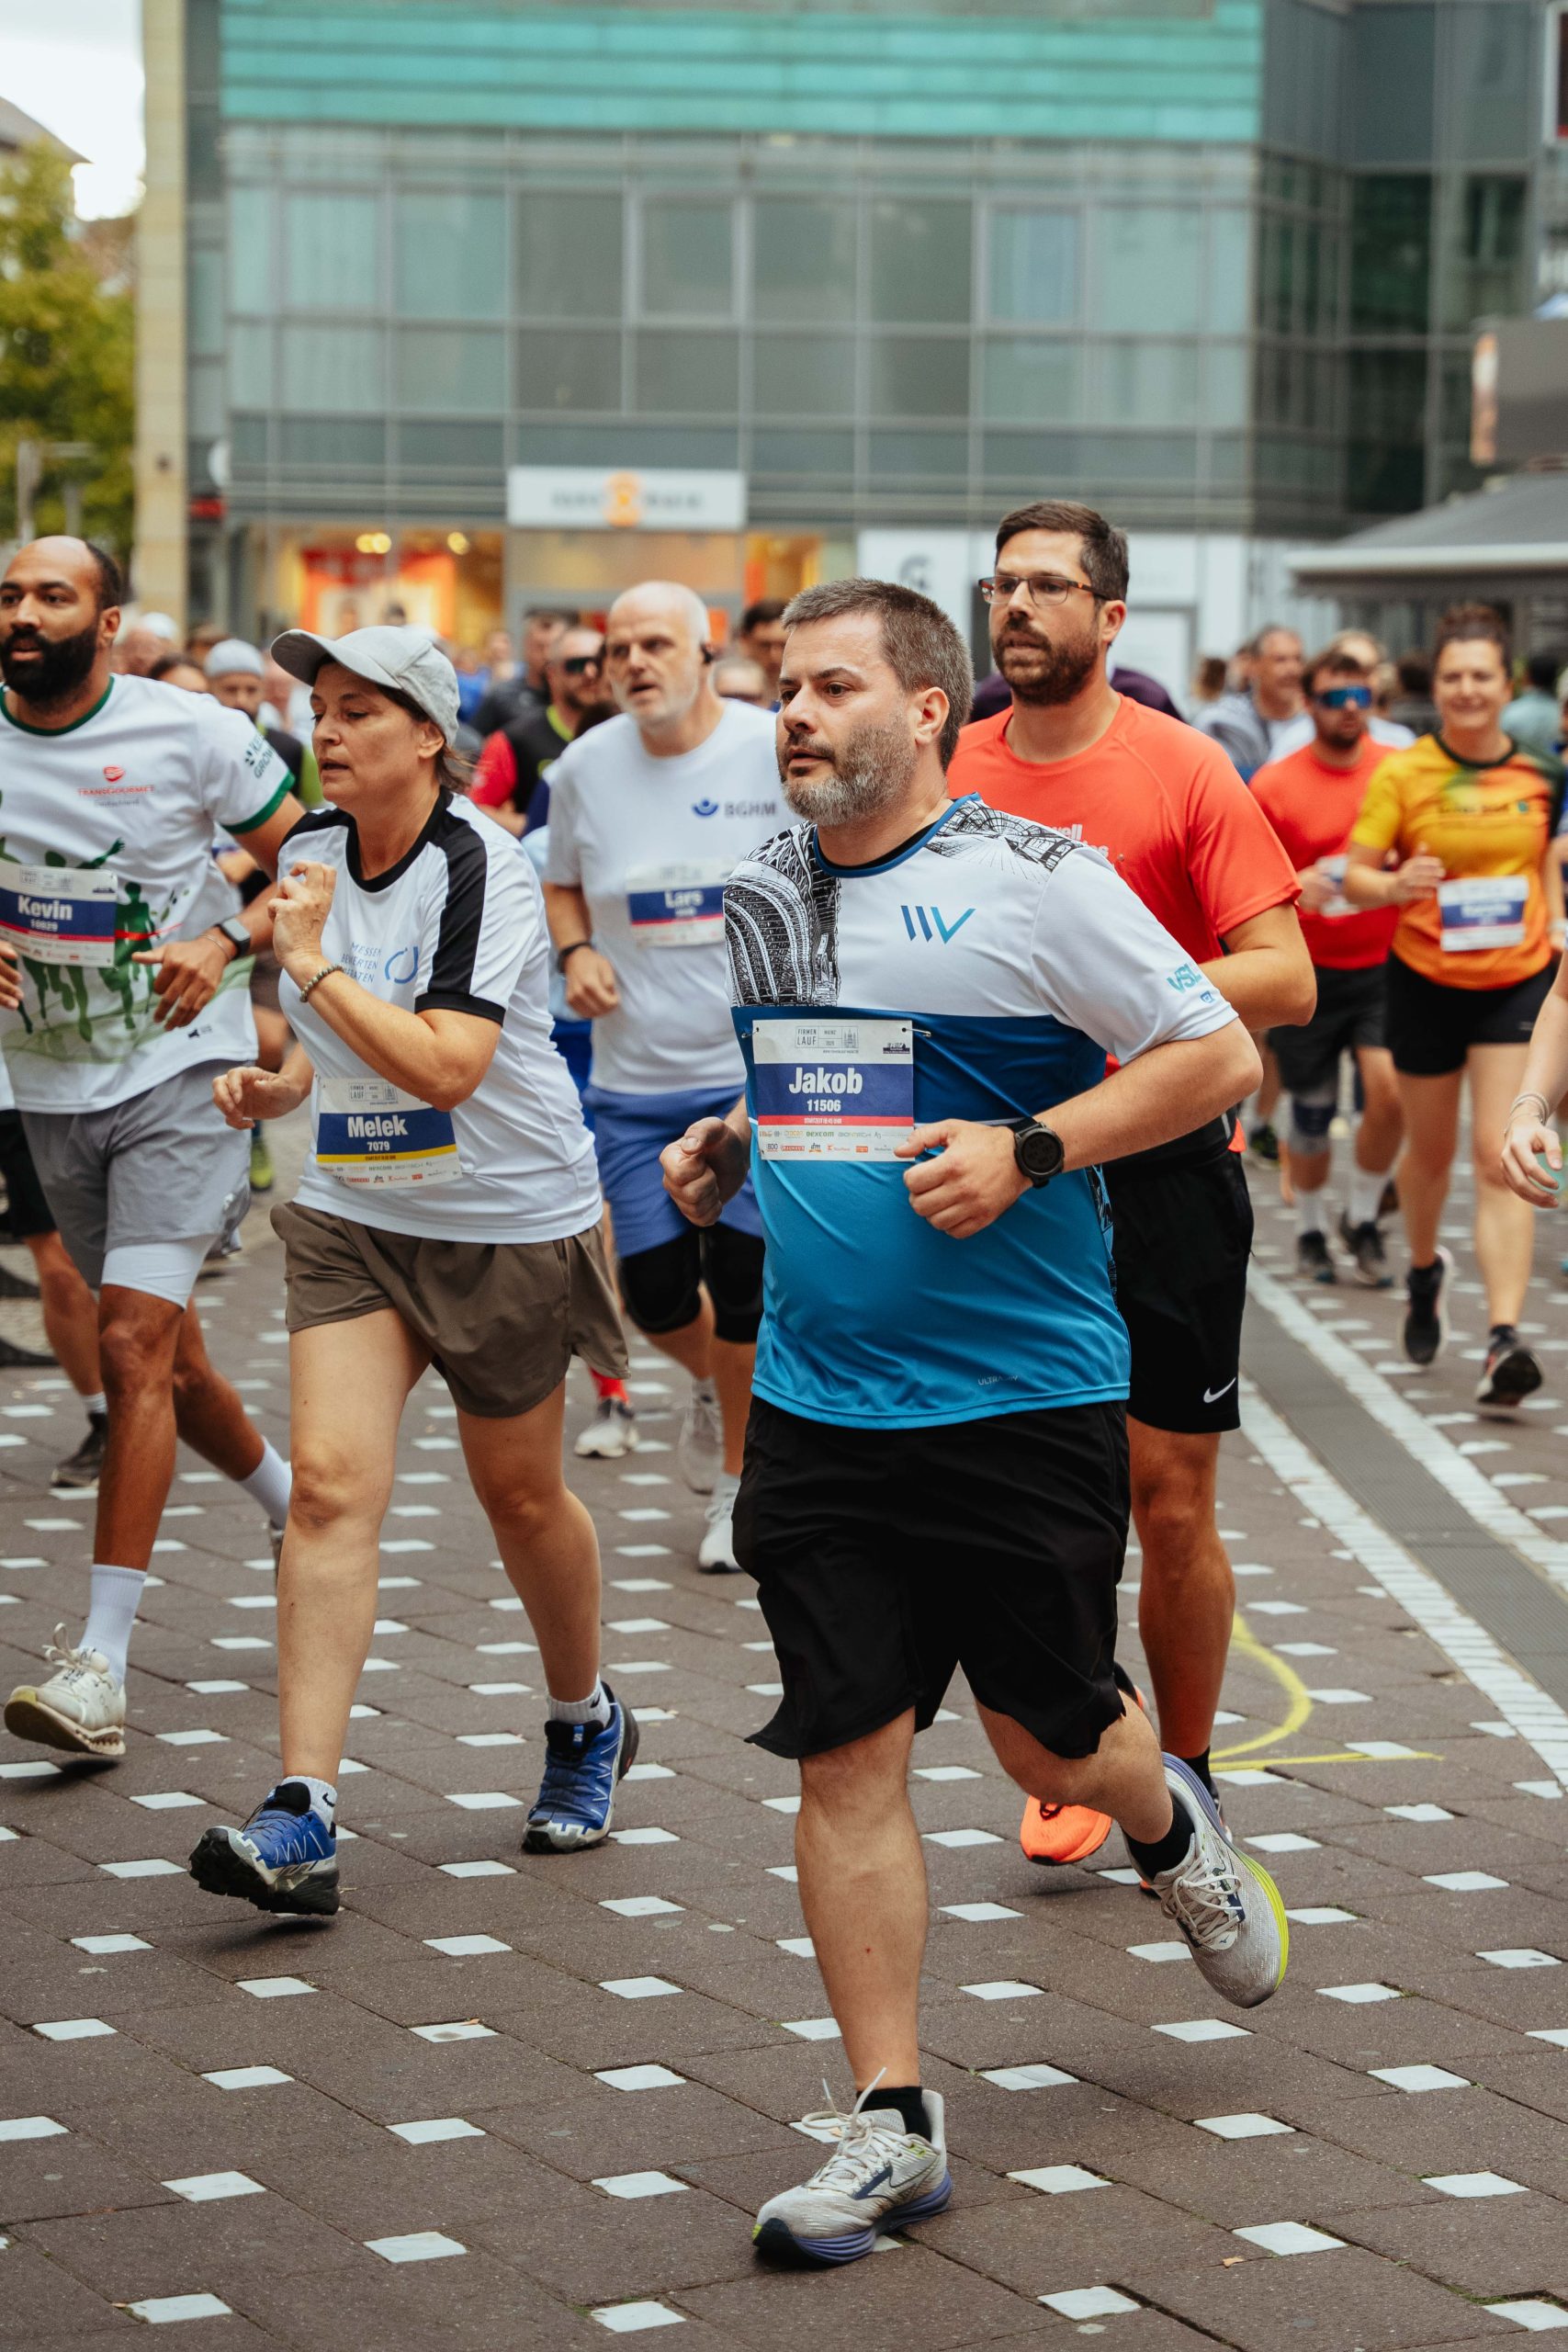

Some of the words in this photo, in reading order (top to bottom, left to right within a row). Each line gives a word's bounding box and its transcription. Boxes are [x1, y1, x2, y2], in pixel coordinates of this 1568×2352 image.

[18, 895, 73, 921] Kevin
[797, 1036, 817, 1046] LAUF
[789, 1067, 863, 1094] Jakob
[807, 1100, 841, 1112] 11506
[347, 1115, 408, 1138] Melek
[367, 1141, 390, 1152] 7079
